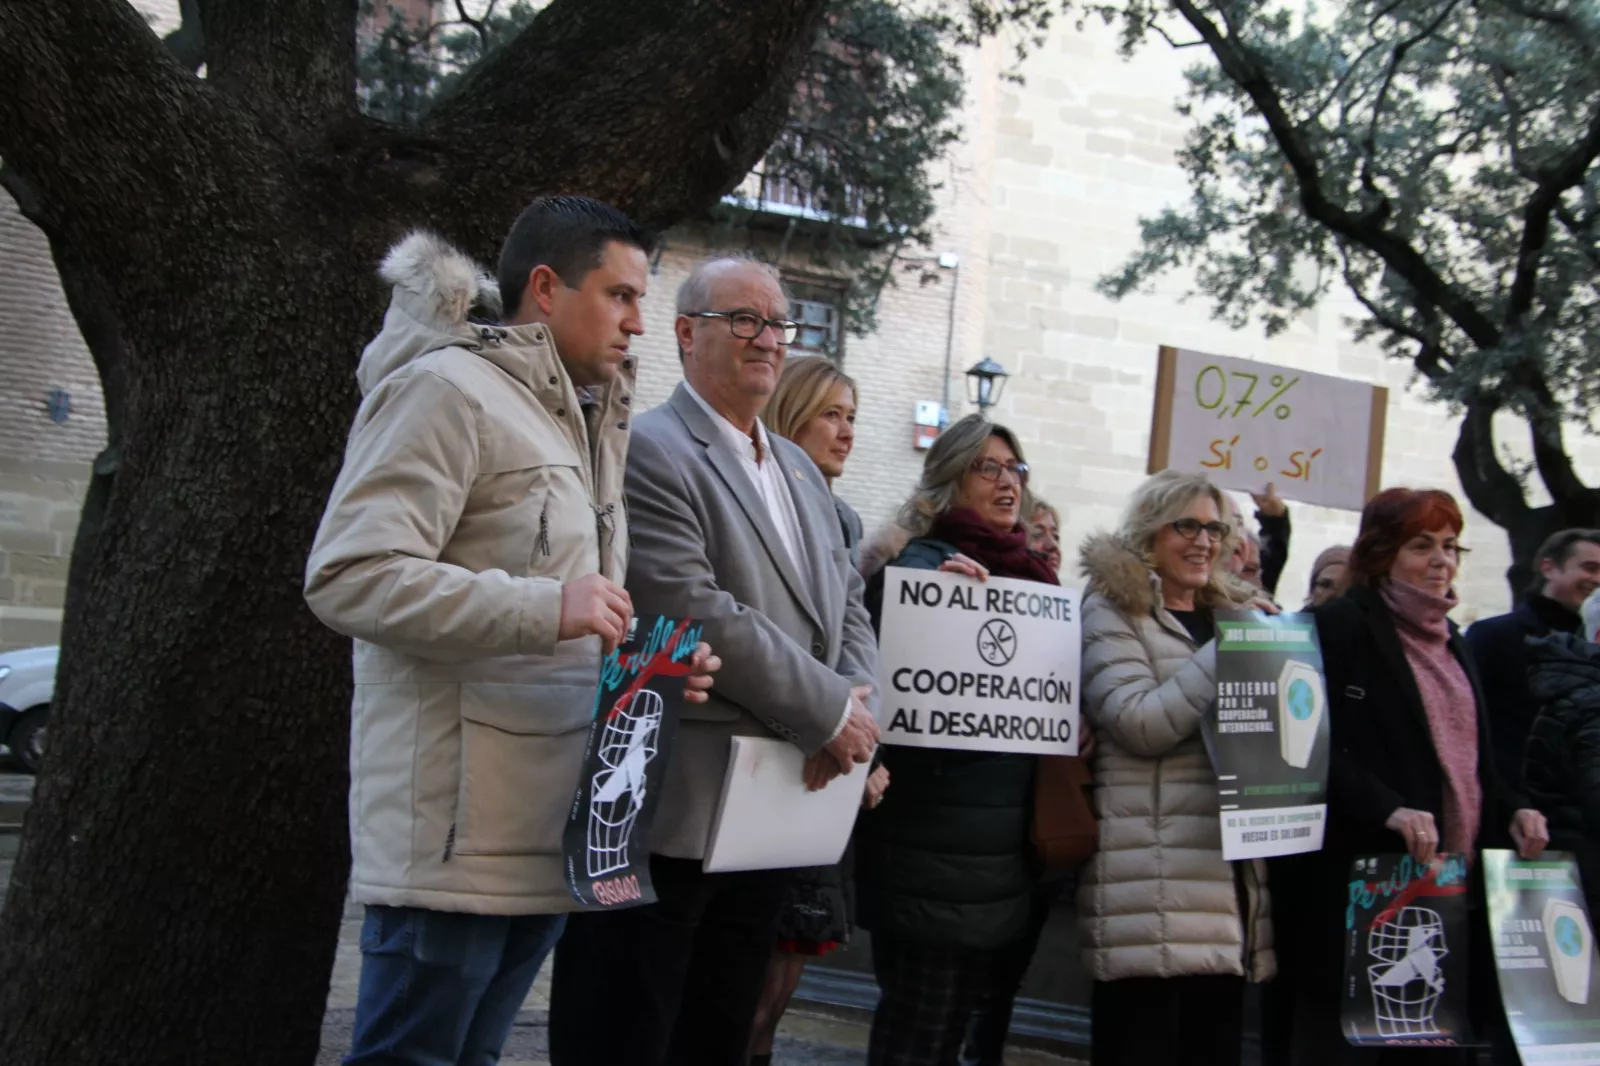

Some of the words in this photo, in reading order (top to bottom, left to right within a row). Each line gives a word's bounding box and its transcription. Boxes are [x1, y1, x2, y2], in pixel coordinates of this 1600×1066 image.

[1196, 365, 1300, 420] 0,7%
[899, 580, 943, 607] NO
[947, 585, 979, 612] AL
[986, 588, 1072, 622] RECORTE
[892, 667, 1072, 705] COOPERACIÓN
[1218, 681, 1277, 696] ENTIERRO
[887, 708, 923, 734] AL
[929, 710, 1071, 743] DESARROLLO
